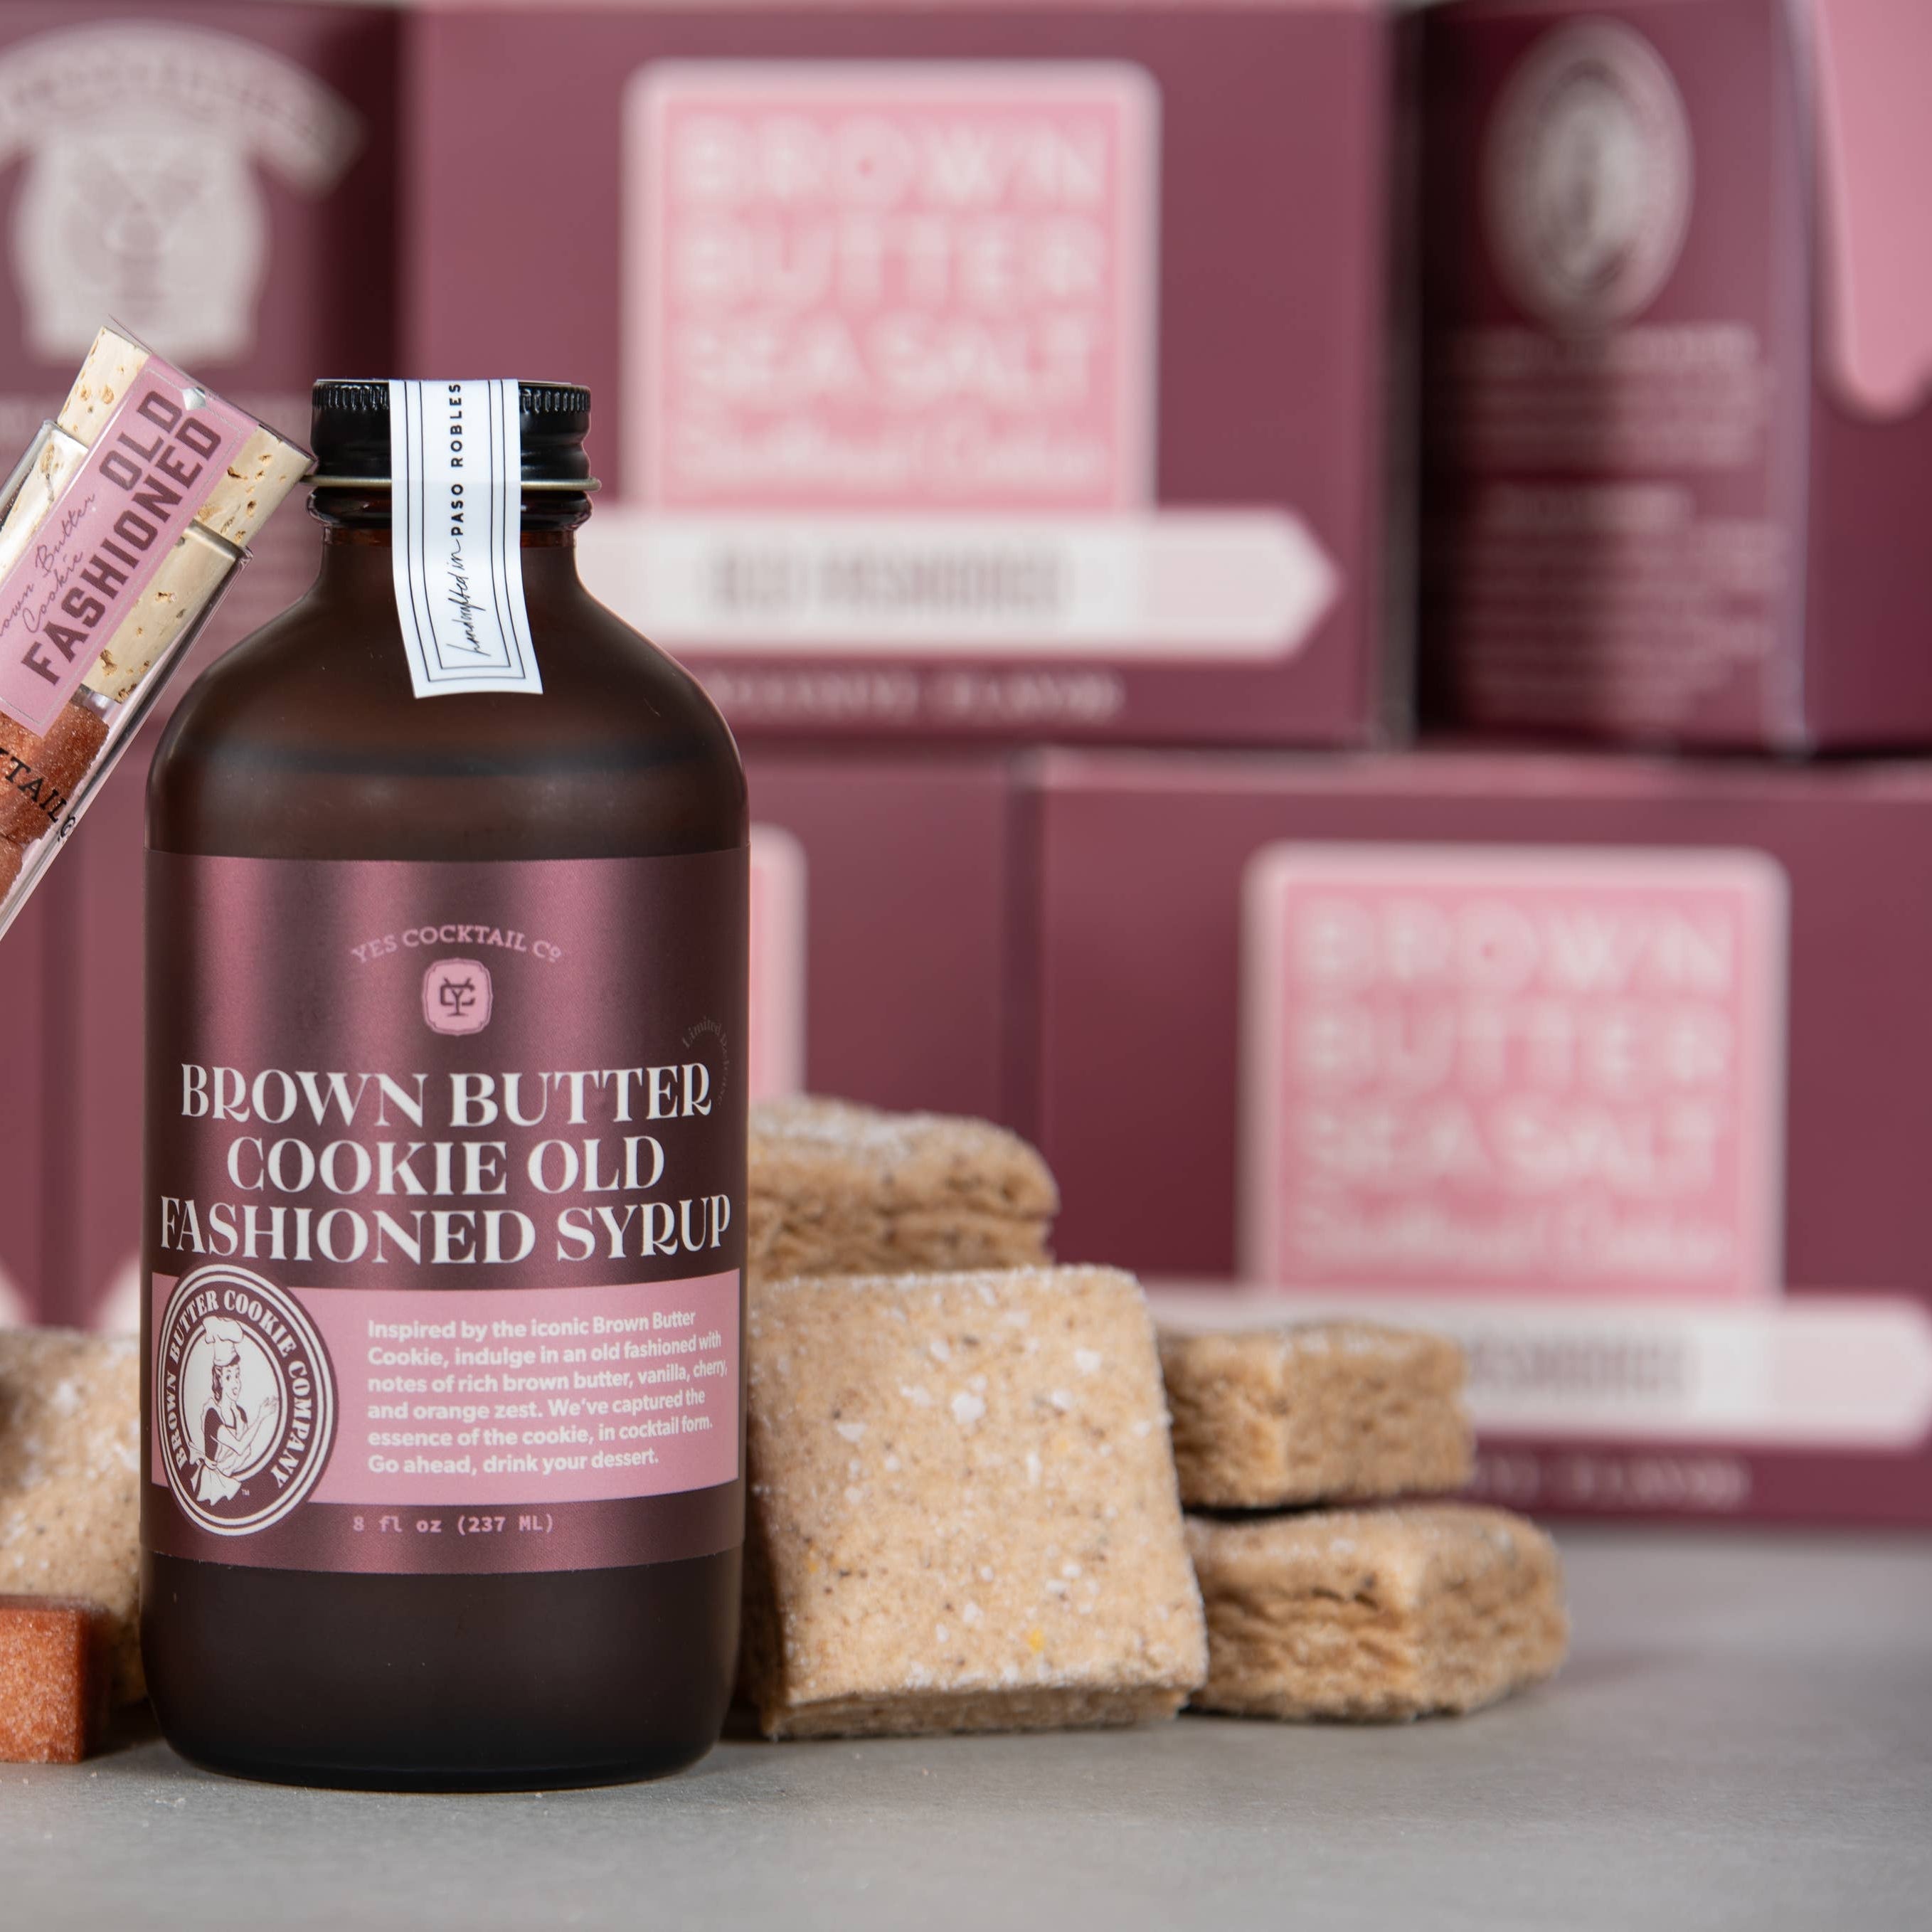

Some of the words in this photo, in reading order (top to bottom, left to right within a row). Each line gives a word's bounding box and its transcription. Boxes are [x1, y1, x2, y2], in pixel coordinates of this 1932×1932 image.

[99, 391, 182, 491] OLD
[448, 383, 464, 467] ROBLES
[35, 494, 96, 578] Butter
[450, 484, 464, 536] PASO
[21, 417, 222, 686] FASHIONED
[22, 551, 83, 634] Cookie
[351, 935, 398, 963] YES
[402, 924, 526, 952] COCKTAIL
[181, 1063, 428, 1127] BROWN
[450, 1063, 711, 1127] BUTTER
[227, 1137, 506, 1196] COOKIE
[528, 1135, 664, 1194] OLD
[161, 1196, 536, 1265] FASHIONED
[557, 1194, 731, 1262] SYRUP
[169, 1289, 220, 1365] BUTTER
[223, 1289, 297, 1358] COOKIE
[368, 1320, 456, 1343] Inspired
[461, 1320, 488, 1343] by
[492, 1320, 527, 1338] the
[531, 1317, 589, 1338] iconic
[593, 1316, 649, 1334] Brown
[652, 1311, 696, 1329] Butter
[368, 1347, 449, 1369] Cookie,
[455, 1347, 536, 1369] indulge
[541, 1345, 559, 1364] in
[563, 1348, 587, 1363] an
[590, 1342, 620, 1362] old
[624, 1334, 696, 1359] fashioned
[699, 1329, 722, 1351] with
[368, 1376, 428, 1393] notes
[432, 1374, 455, 1393] of
[458, 1374, 498, 1393] rich
[502, 1373, 568, 1392] brown
[573, 1371, 633, 1389] butter,
[637, 1364, 691, 1385] vanilla,
[693, 1359, 728, 1378] cherry,
[368, 1401, 408, 1419] and
[413, 1404, 490, 1424] orange
[494, 1401, 543, 1418] zest.
[612, 1389, 683, 1416] captured
[686, 1388, 706, 1406] the
[166, 1369, 189, 1470] BROWN
[270, 1360, 312, 1489] COMPANY
[368, 1431, 453, 1447] essence
[457, 1427, 481, 1446] of
[483, 1427, 518, 1446] the
[521, 1423, 594, 1445] cookie,
[598, 1423, 615, 1441] in
[619, 1416, 679, 1440] cocktail
[681, 1415, 713, 1434] form.
[368, 1454, 399, 1473] Go
[403, 1455, 477, 1476] ahead,
[482, 1453, 538, 1473] drink
[542, 1455, 588, 1477] your
[591, 1448, 659, 1469] dessert.
[353, 1516, 365, 1532] 8
[378, 1515, 403, 1533] fl
[416, 1519, 442, 1533] oz
[457, 1515, 506, 1536] (237
[519, 1513, 553, 1533] ML)
